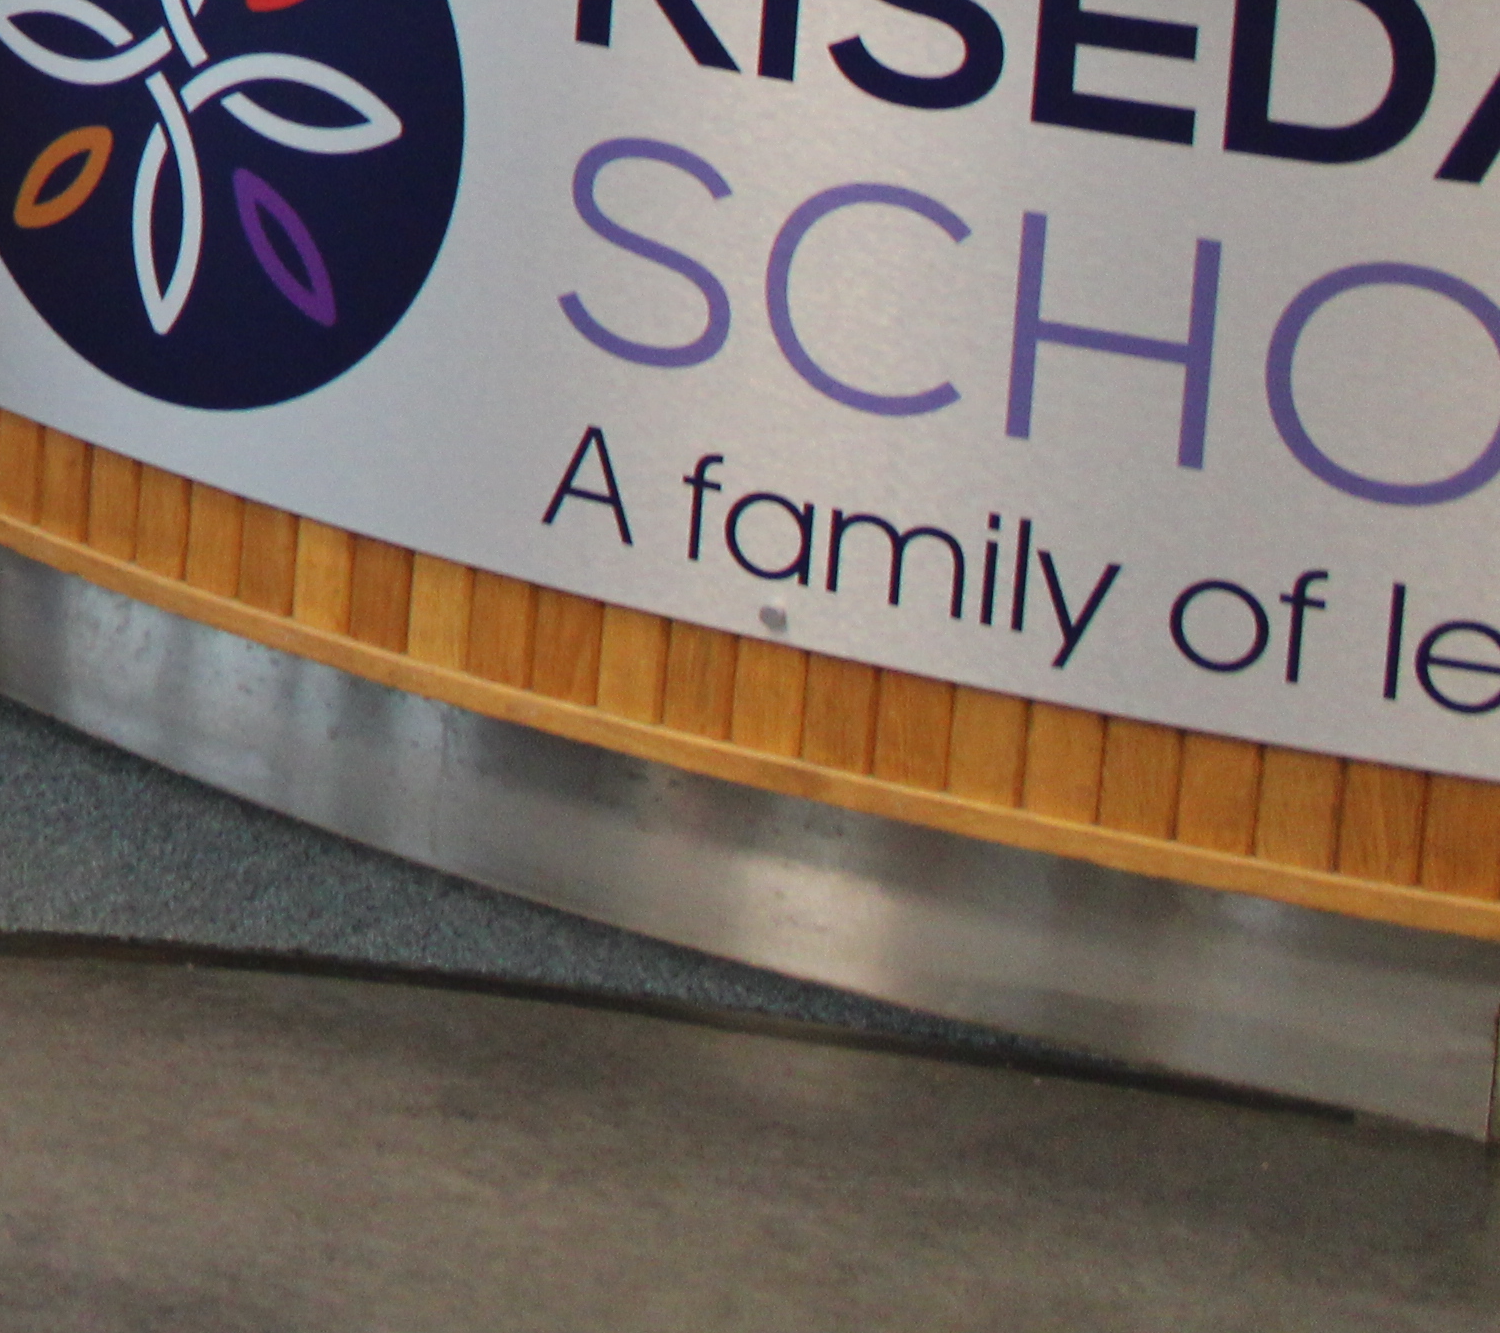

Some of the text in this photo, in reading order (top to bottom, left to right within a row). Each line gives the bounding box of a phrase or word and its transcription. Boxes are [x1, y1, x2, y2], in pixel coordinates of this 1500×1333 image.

[557, 137, 1500, 508] SCHO
[542, 425, 1500, 714] A family of le
